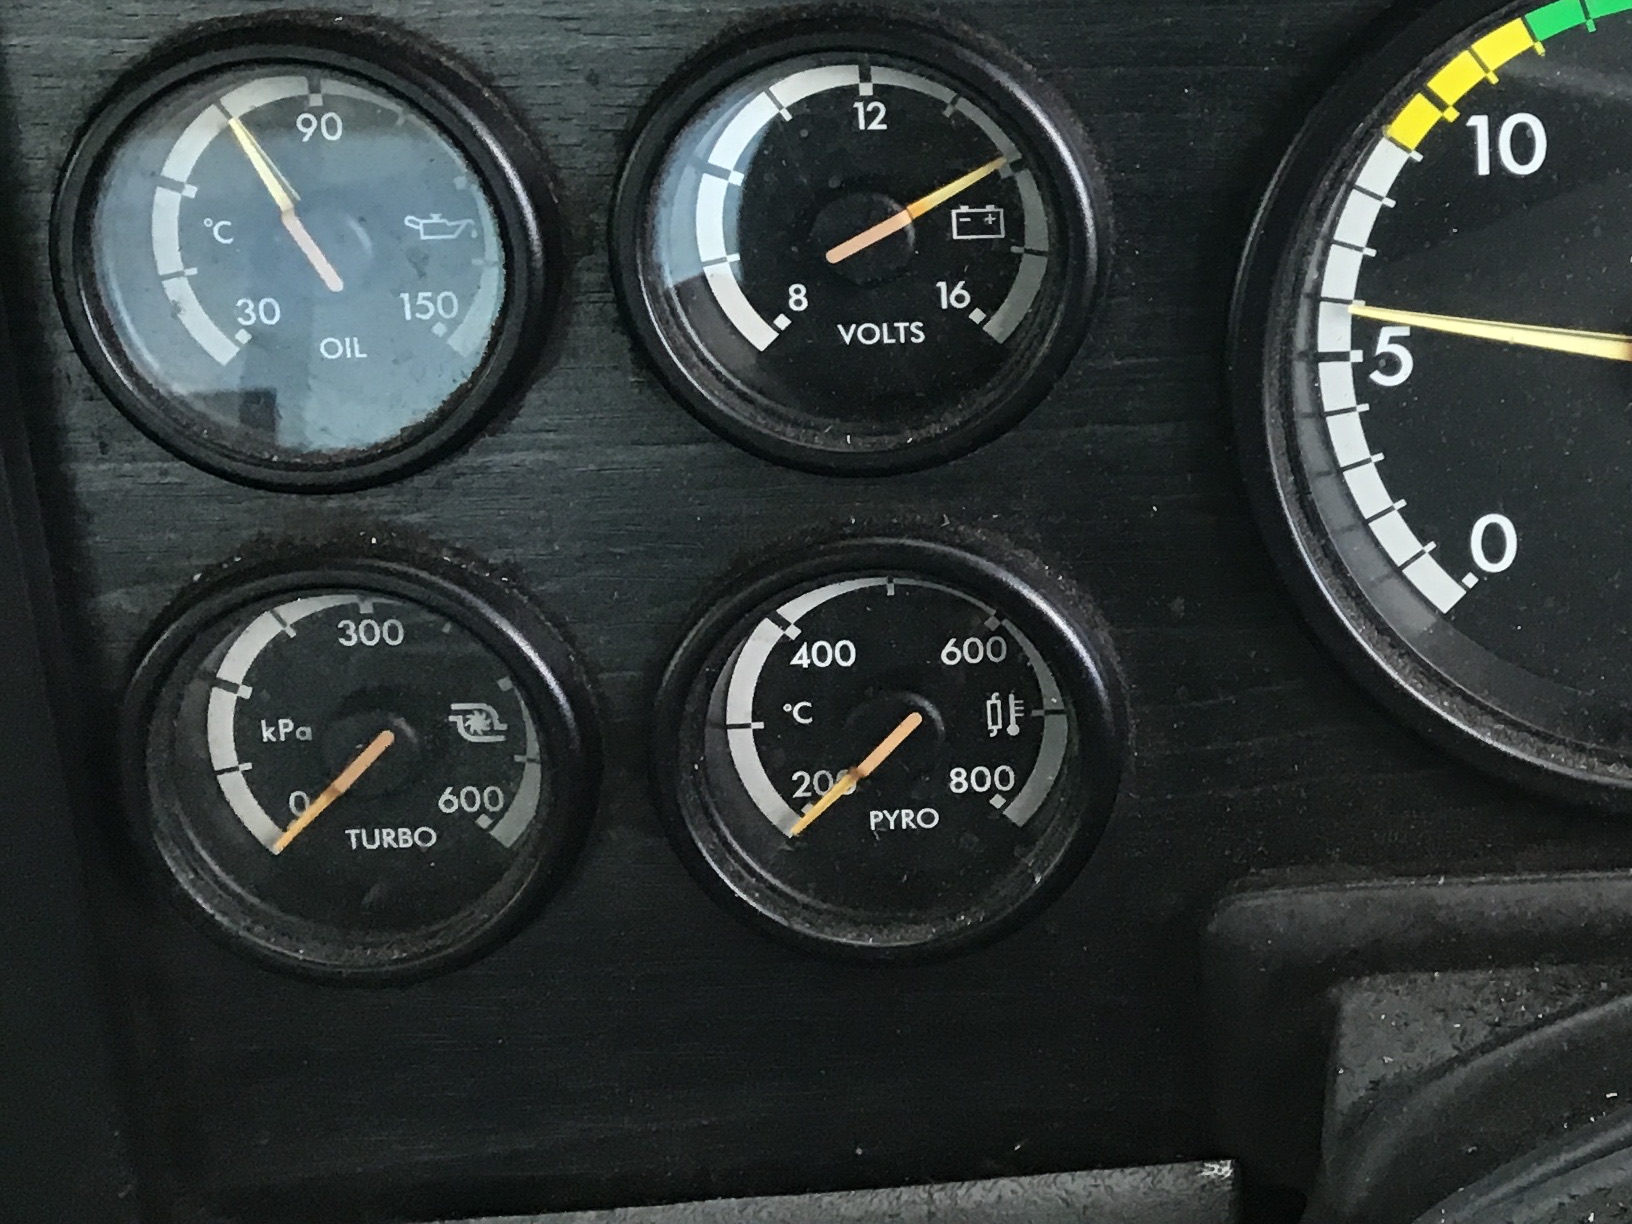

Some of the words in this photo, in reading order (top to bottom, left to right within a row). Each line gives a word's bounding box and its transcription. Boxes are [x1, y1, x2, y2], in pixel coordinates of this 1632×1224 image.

[296, 112, 343, 142] 90
[853, 101, 888, 130] 12
[1465, 114, 1547, 176] 10
[203, 218, 234, 244] °C
[400, 290, 460, 321] 150
[788, 284, 808, 311] 8
[937, 281, 972, 309] 16
[235, 297, 281, 326] 30
[836, 321, 926, 345] VOLTS
[320, 337, 368, 360] OIL
[1368, 326, 1414, 389] 5
[1469, 513, 1519, 573] 0
[336, 618, 405, 647] 300
[790, 639, 857, 669] 400
[940, 636, 1008, 666] 600
[782, 700, 813, 725] °C
[259, 718, 313, 743] kPa
[791, 768, 857, 798] 200
[949, 764, 1016, 794] 800
[288, 791, 311, 816] 0
[437, 786, 505, 814] 600
[869, 808, 940, 831] PYRO
[344, 826, 438, 851] TURBO
